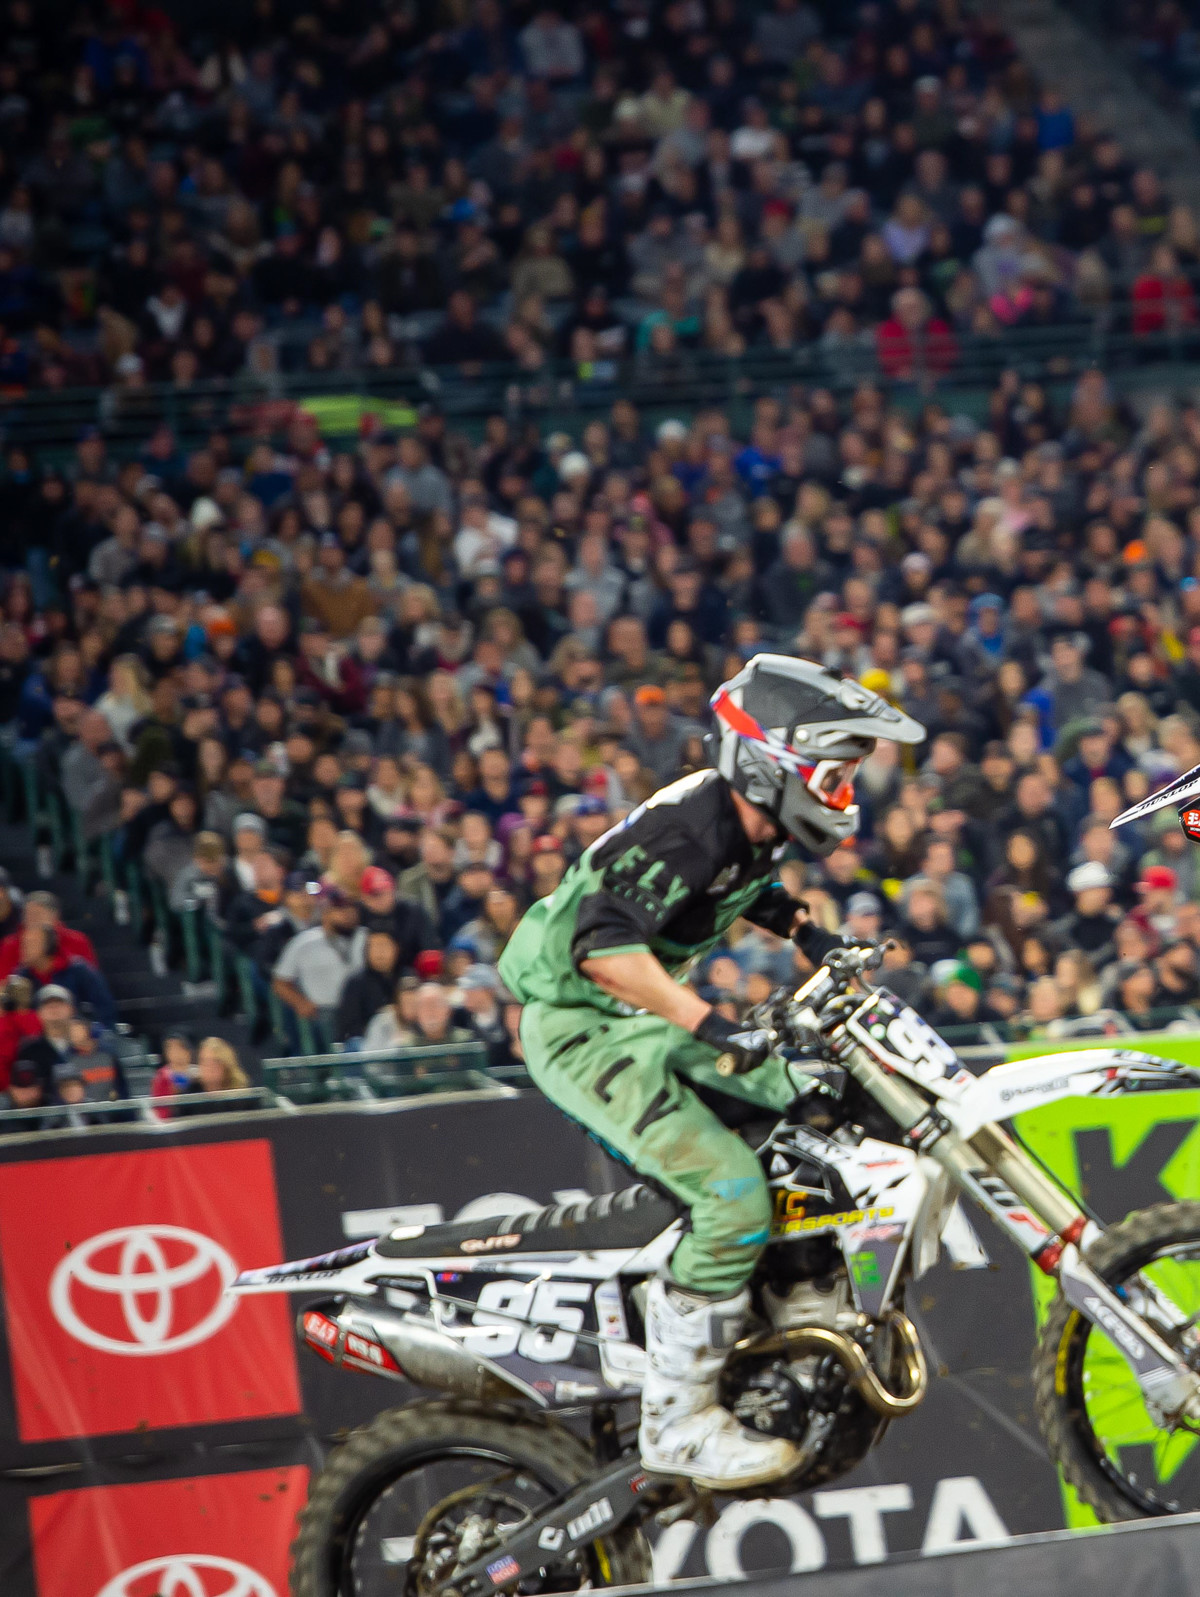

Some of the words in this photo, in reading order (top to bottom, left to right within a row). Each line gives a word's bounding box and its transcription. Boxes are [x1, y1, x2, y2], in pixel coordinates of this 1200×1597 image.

[1137, 780, 1199, 811] DUNLOP
[611, 844, 691, 909] FLY
[648, 1476, 1011, 1588] YOTA
